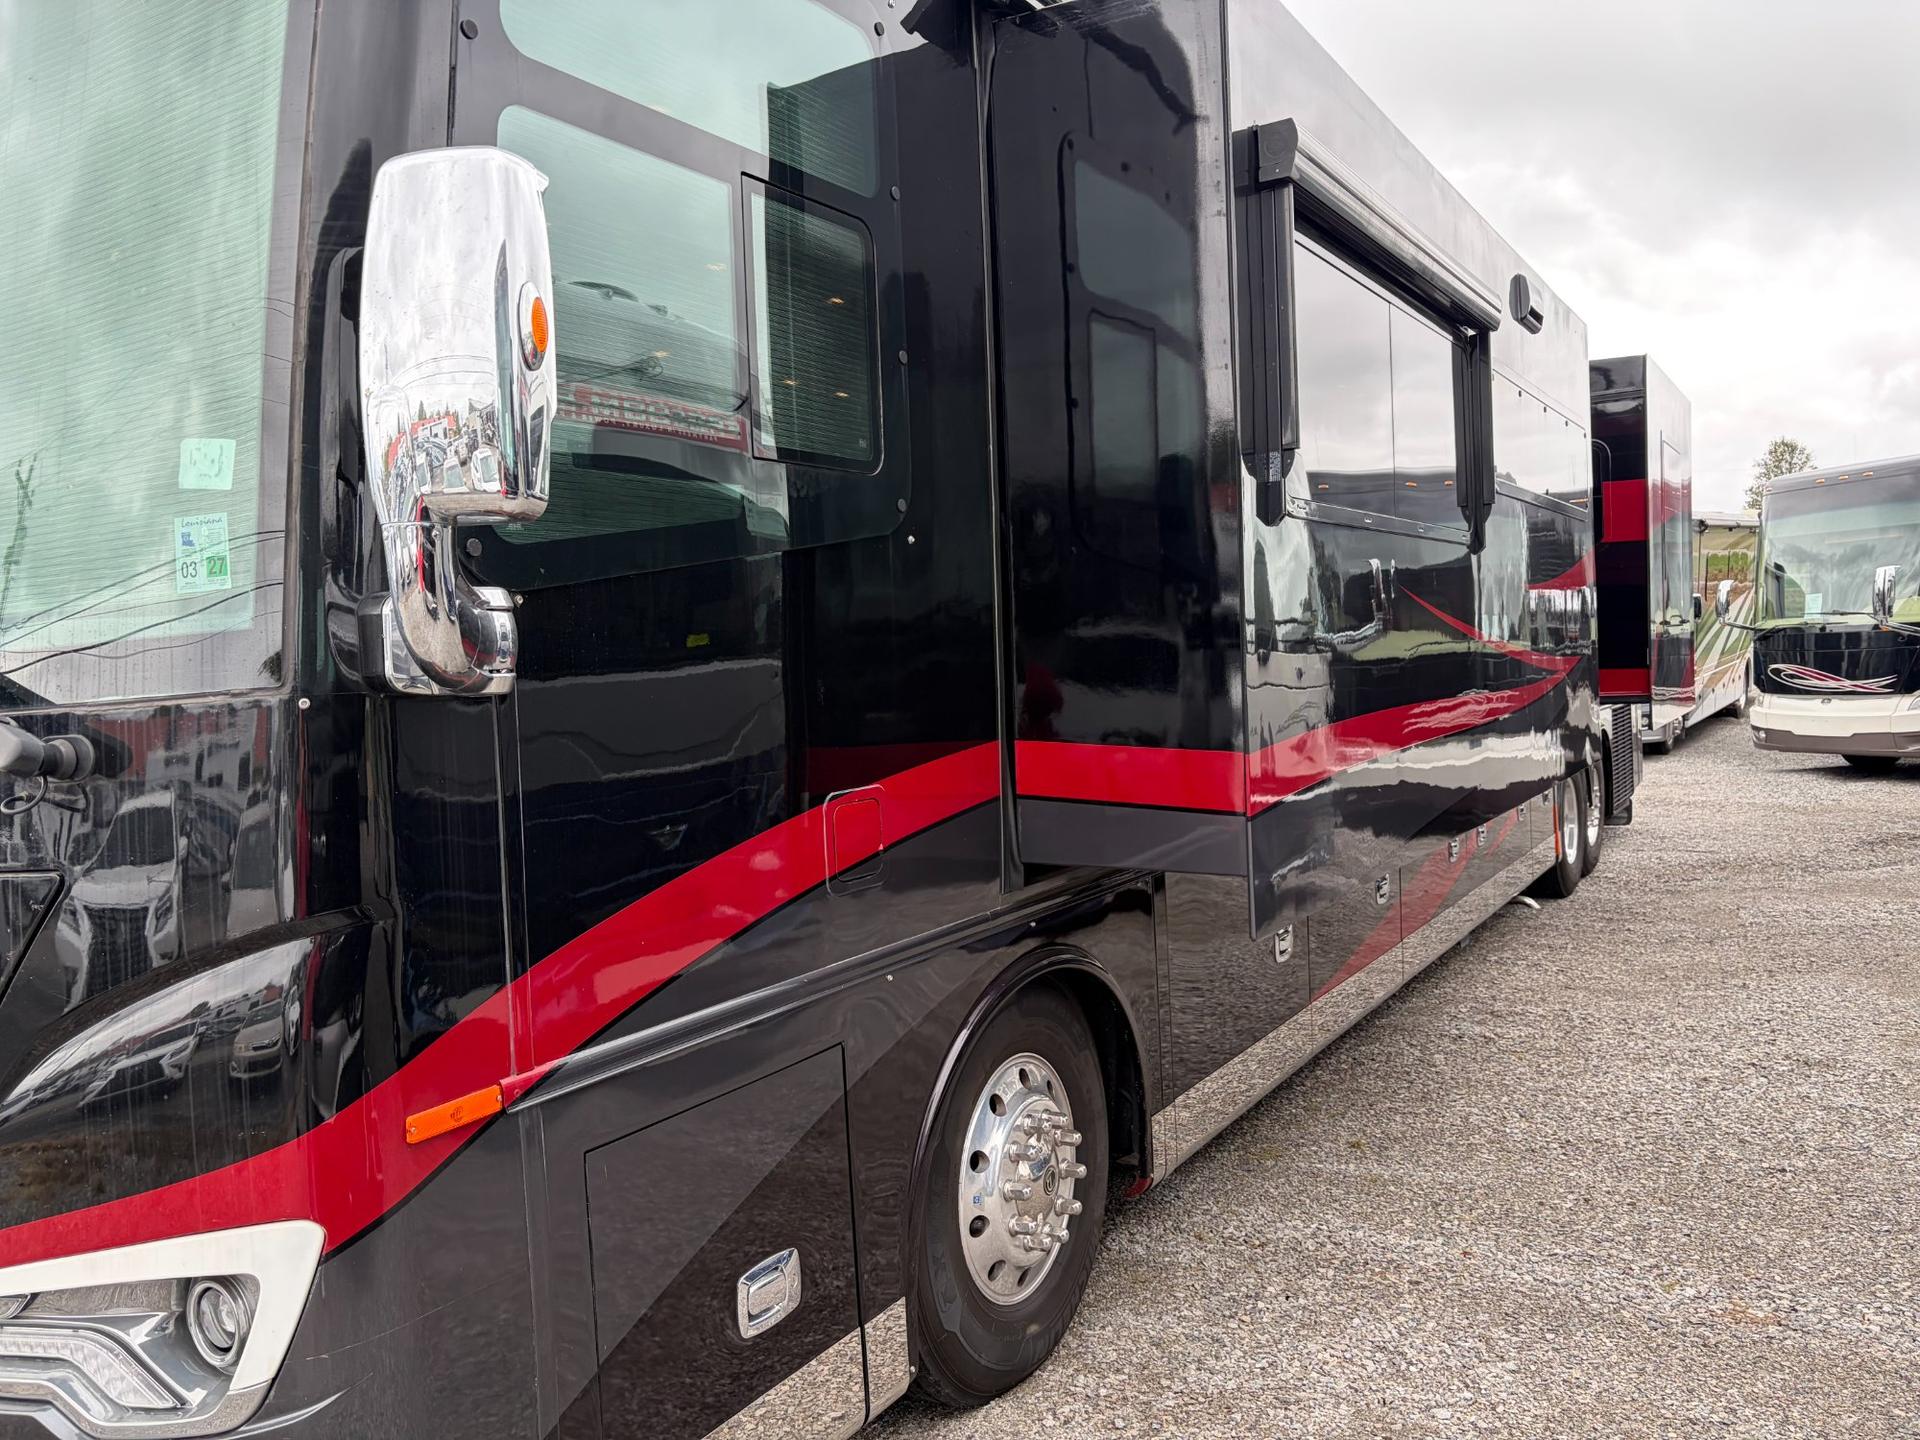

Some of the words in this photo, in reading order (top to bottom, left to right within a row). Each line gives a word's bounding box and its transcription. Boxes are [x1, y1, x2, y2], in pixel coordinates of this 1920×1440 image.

[181, 517, 223, 528] Louisiana
[181, 560, 198, 579] 03
[208, 558, 225, 575] 27
